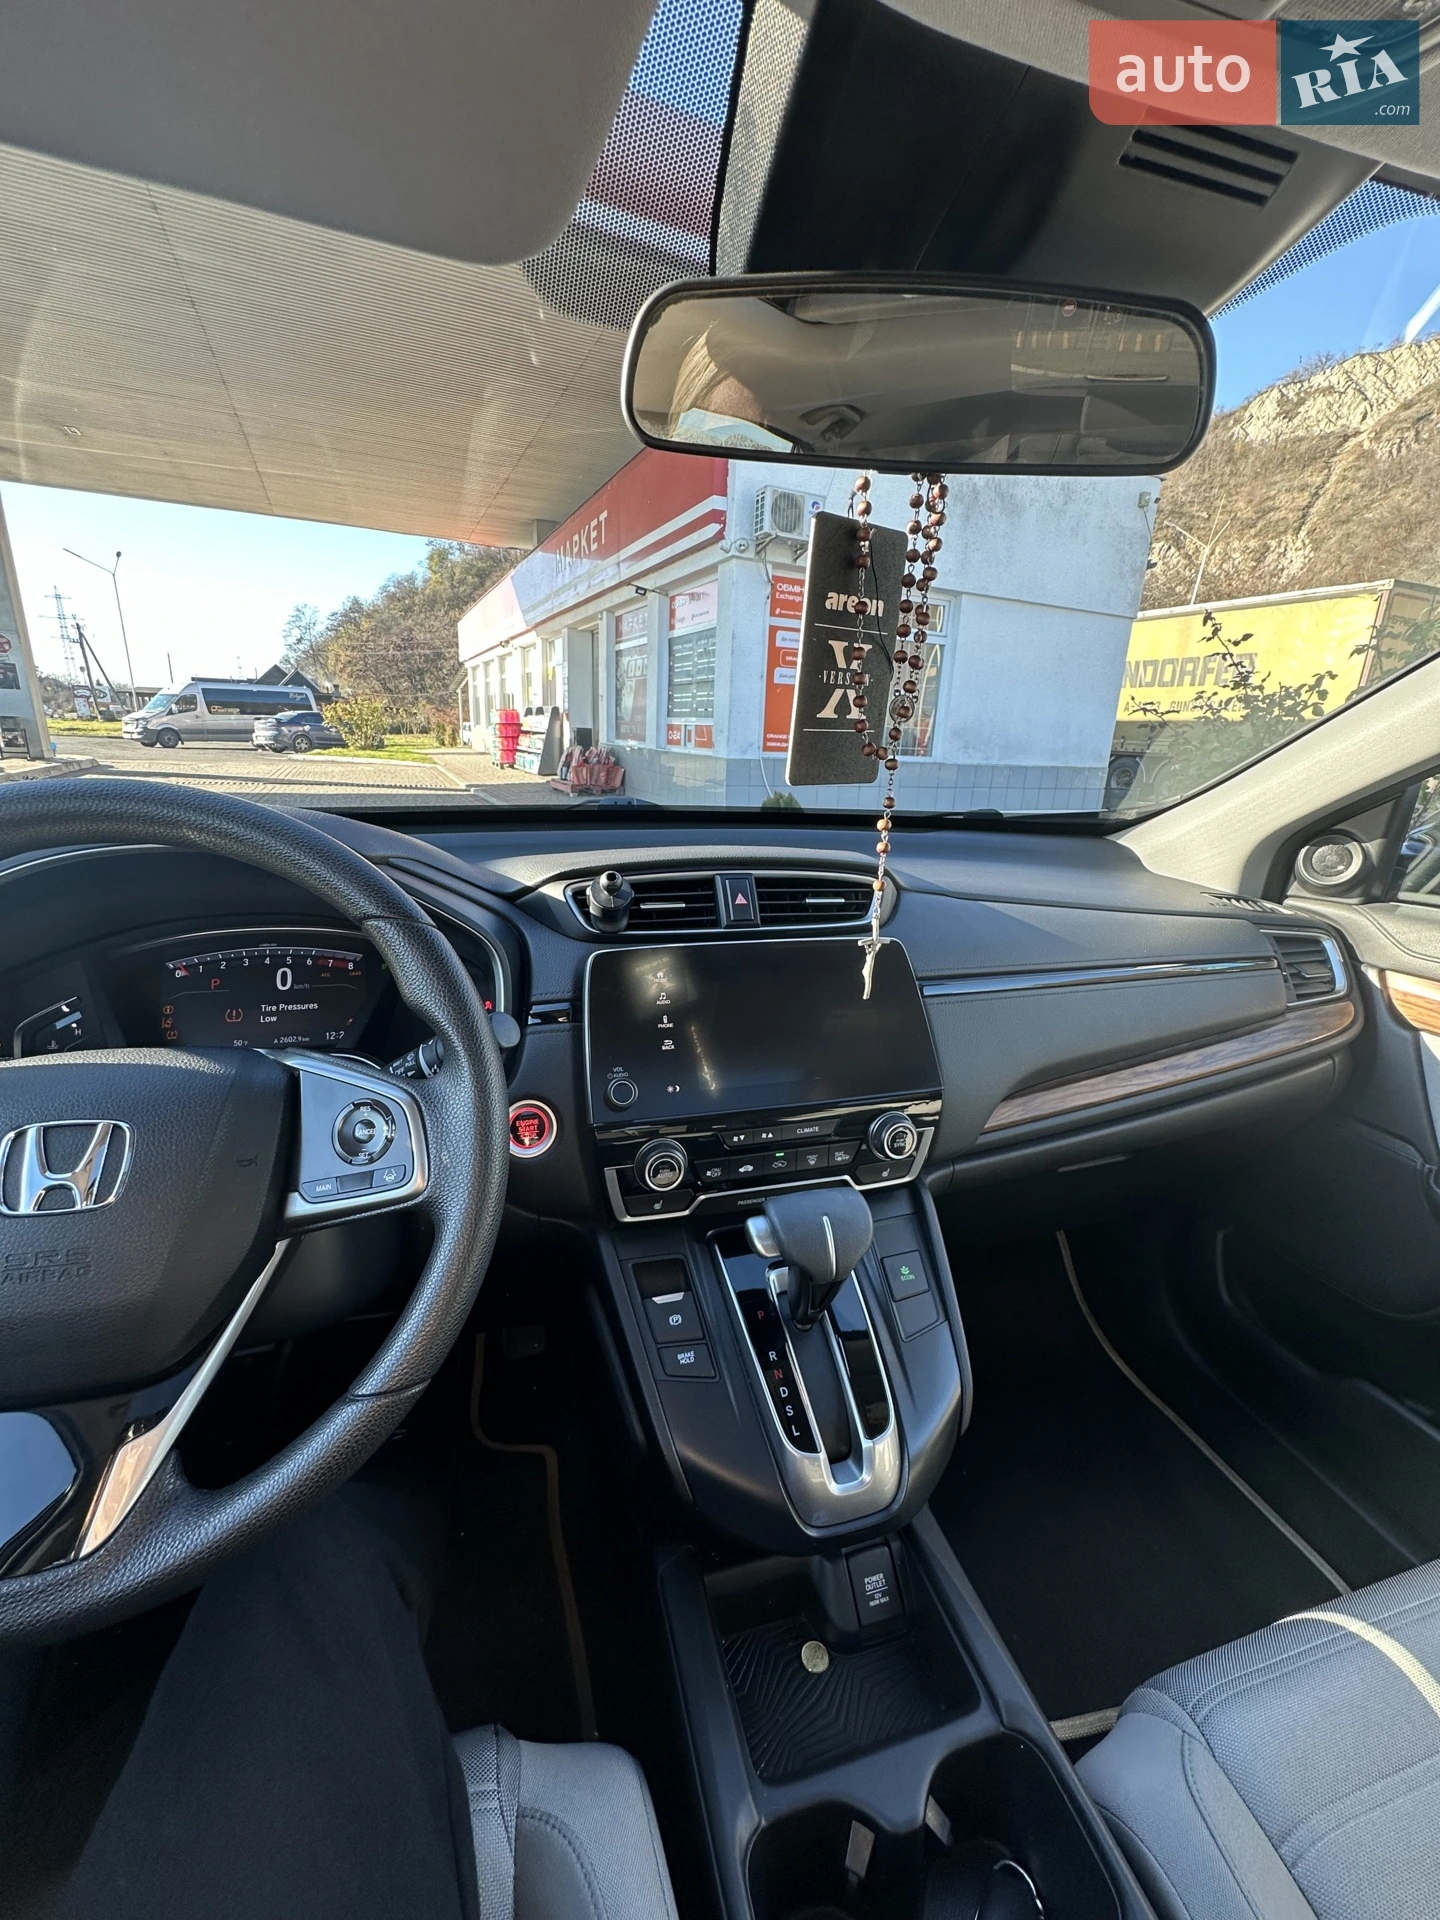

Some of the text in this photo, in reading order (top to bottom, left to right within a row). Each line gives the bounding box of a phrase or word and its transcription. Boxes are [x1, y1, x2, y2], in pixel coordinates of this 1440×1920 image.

[775, 592, 803, 602] Exchange
[823, 669, 871, 687] VERSN
[220, 961, 226, 969] 2
[243, 958, 249, 966] 3
[264, 957, 270, 965] 4
[286, 957, 292, 965] 5
[307, 957, 313, 966] 6
[328, 959, 333, 968] 7
[211, 978, 220, 990] P
[276, 967, 293, 991] 0
[293, 982, 310, 990] km/h
[260, 1002, 318, 1012] Tire Pressures
[260, 1015, 277, 1023] Low
[233, 1039, 243, 1047] 50
[516, 1119, 539, 1127] ENGINE
[796, 1126, 819, 1134] CLIMATE
[315, 1183, 332, 1192] MAIN
[737, 1197, 765, 1205] PASSENGER
[4, 1247, 93, 1268] SRS
[757, 1310, 764, 1320] P
[677, 1350, 695, 1360] BRAKE
[769, 1351, 777, 1361] R
[679, 1356, 695, 1365] HOLD
[774, 1368, 784, 1379] N
[780, 1387, 789, 1398] D
[785, 1405, 794, 1416] S
[792, 1425, 800, 1436] L
[864, 1573, 884, 1584] POWER
[865, 1578, 886, 1591] OUTLET
